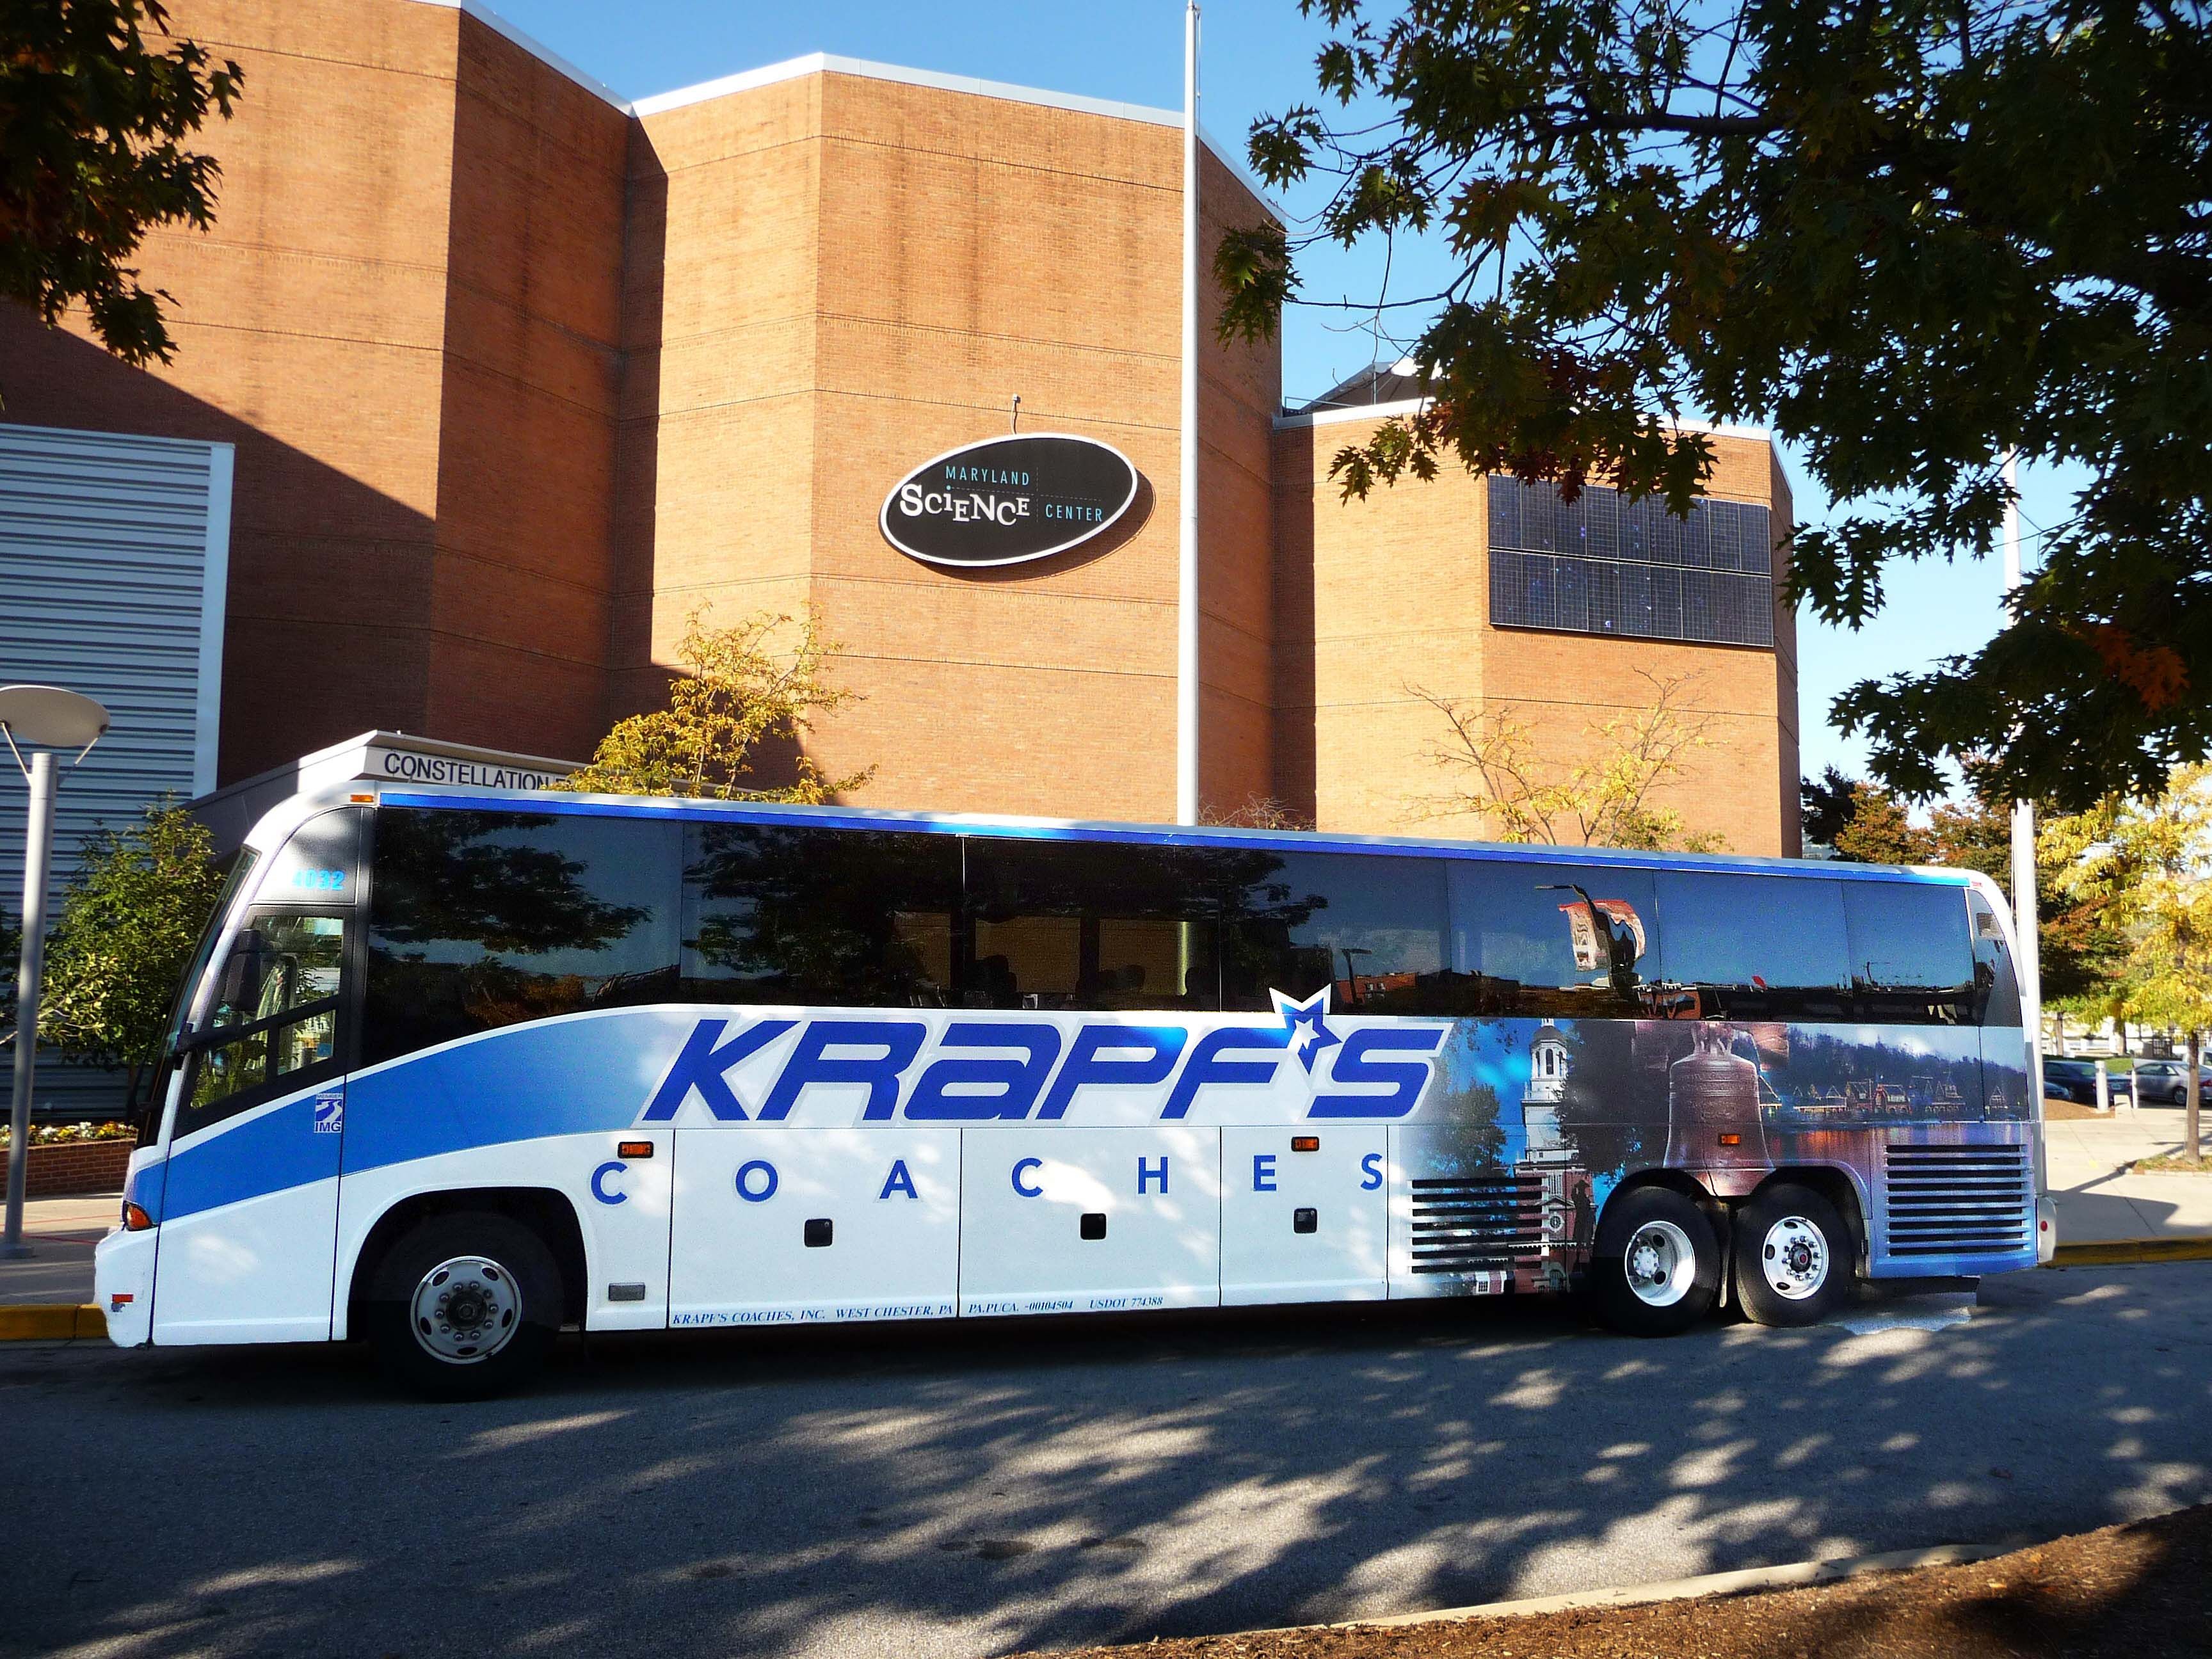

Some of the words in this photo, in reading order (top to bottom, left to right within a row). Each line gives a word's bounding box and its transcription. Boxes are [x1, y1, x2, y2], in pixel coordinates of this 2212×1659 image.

[945, 465, 1030, 486] MARYLAND
[1045, 504, 1103, 523] CENTER
[385, 753, 549, 790] CONSTELLATION
[293, 868, 344, 891] 4032
[316, 1121, 341, 1132] IMG
[590, 1153, 1384, 1205] COACHES
[1089, 1297, 1128, 1309] USDOT
[673, 1313, 728, 1324] KRAPF'S
[800, 1310, 825, 1320] INC.
[836, 1308, 871, 1318] WEST
[939, 1304, 953, 1315] PA
